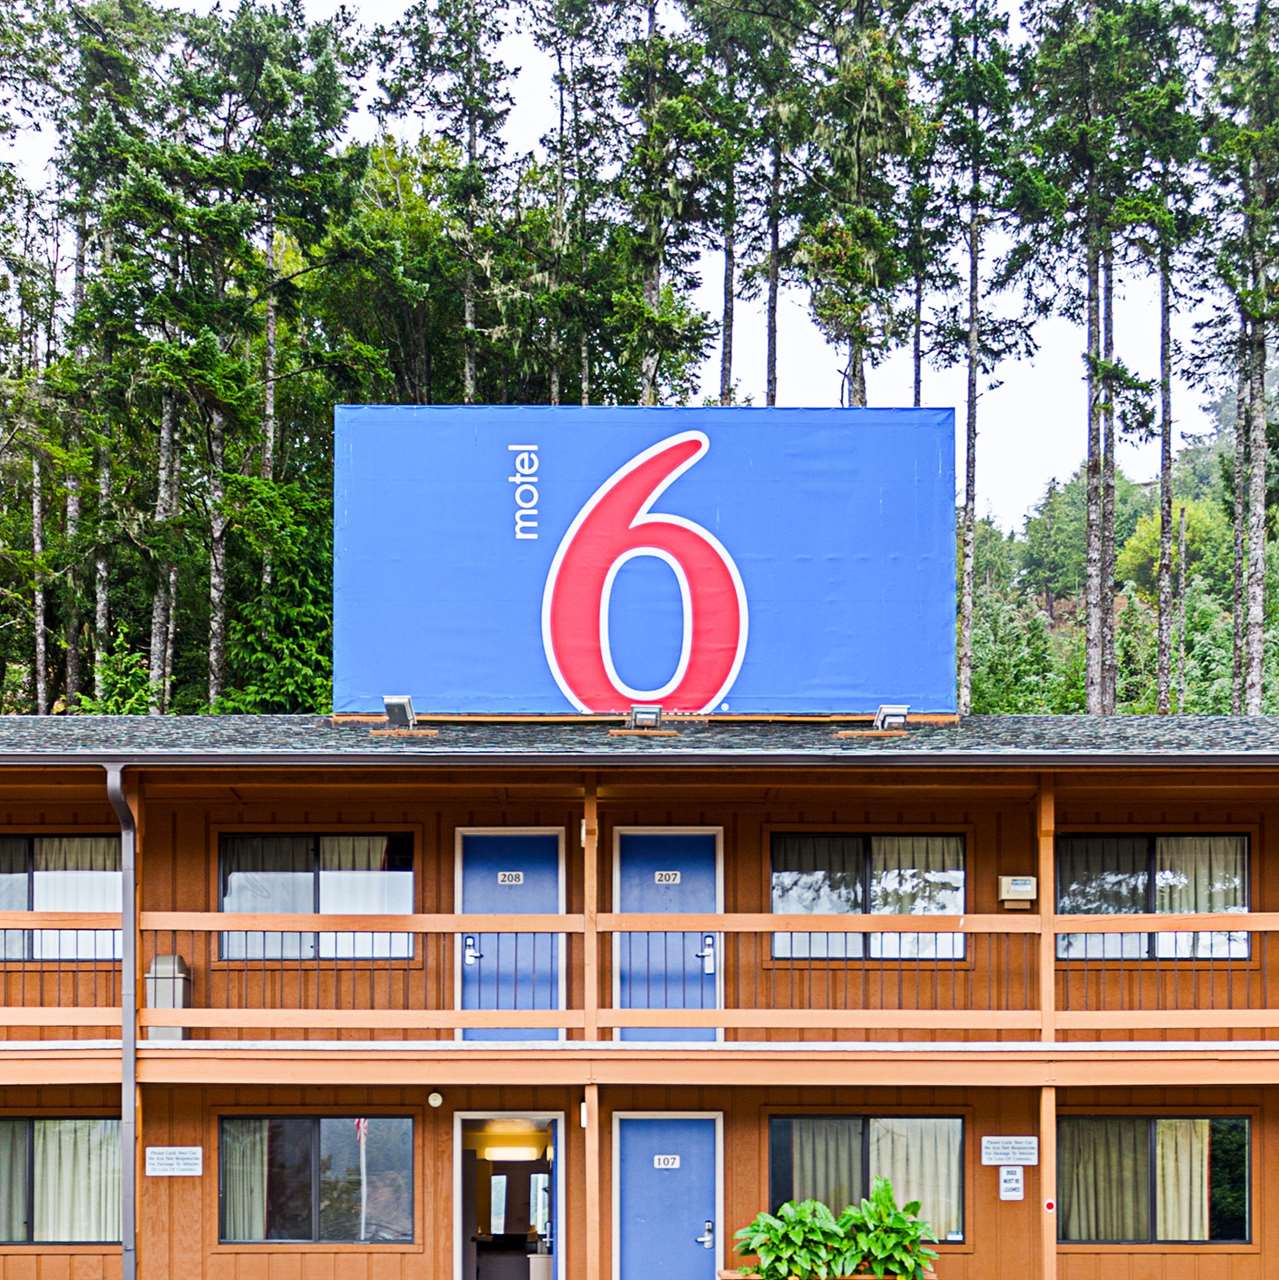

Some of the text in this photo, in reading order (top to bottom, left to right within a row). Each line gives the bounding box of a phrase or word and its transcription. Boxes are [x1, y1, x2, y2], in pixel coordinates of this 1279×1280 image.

[507, 430, 749, 715] motel 6
[500, 873, 521, 884] 208
[657, 872, 677, 883] 207
[657, 1157, 677, 1167] 107
